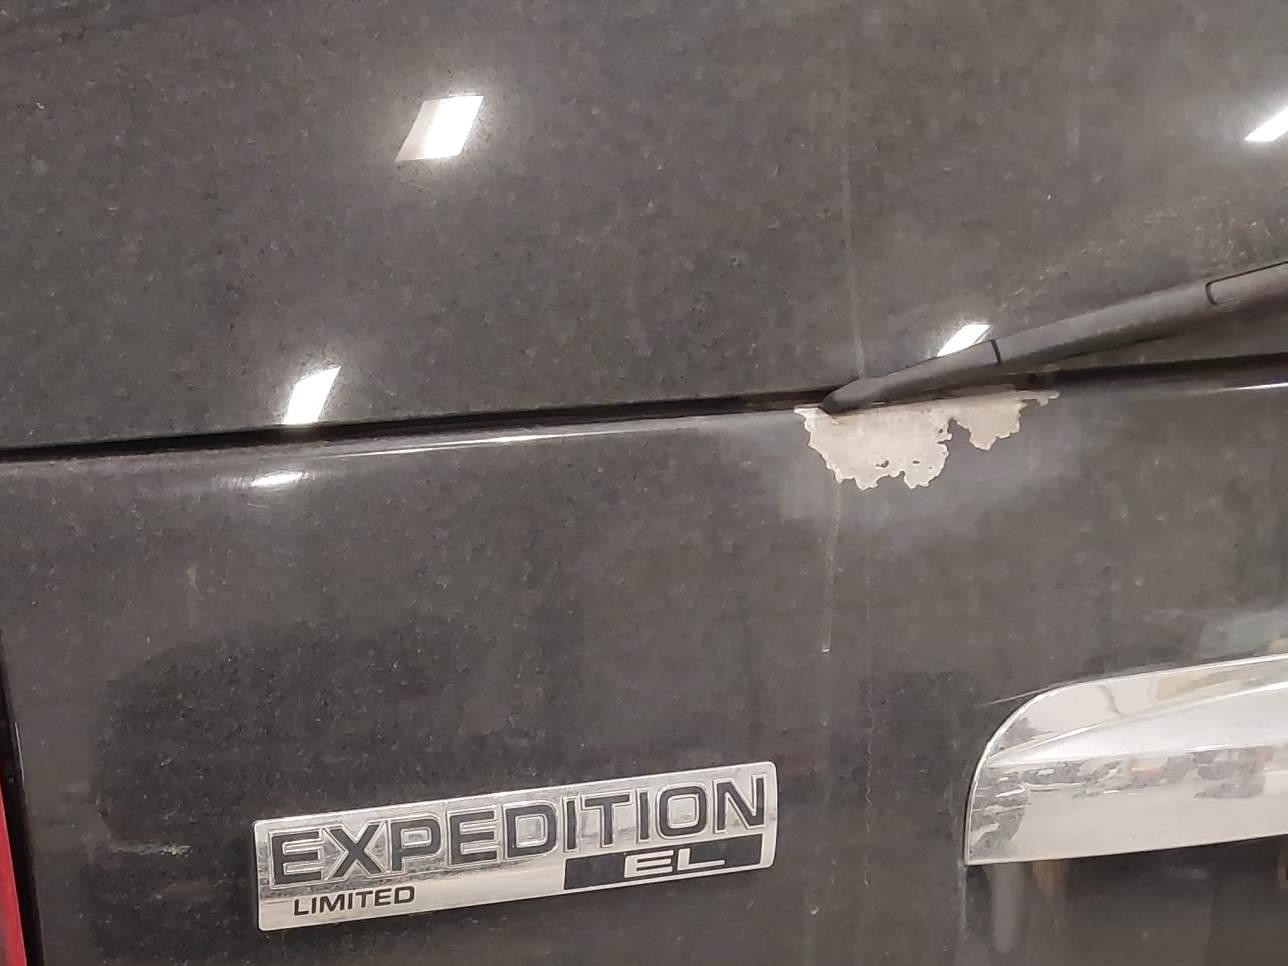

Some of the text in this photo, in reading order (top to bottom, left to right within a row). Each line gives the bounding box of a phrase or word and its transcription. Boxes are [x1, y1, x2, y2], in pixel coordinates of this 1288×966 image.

[269, 775, 767, 888] EXPEDITION
[623, 850, 726, 878] EL
[294, 886, 416, 917] LIMITED
